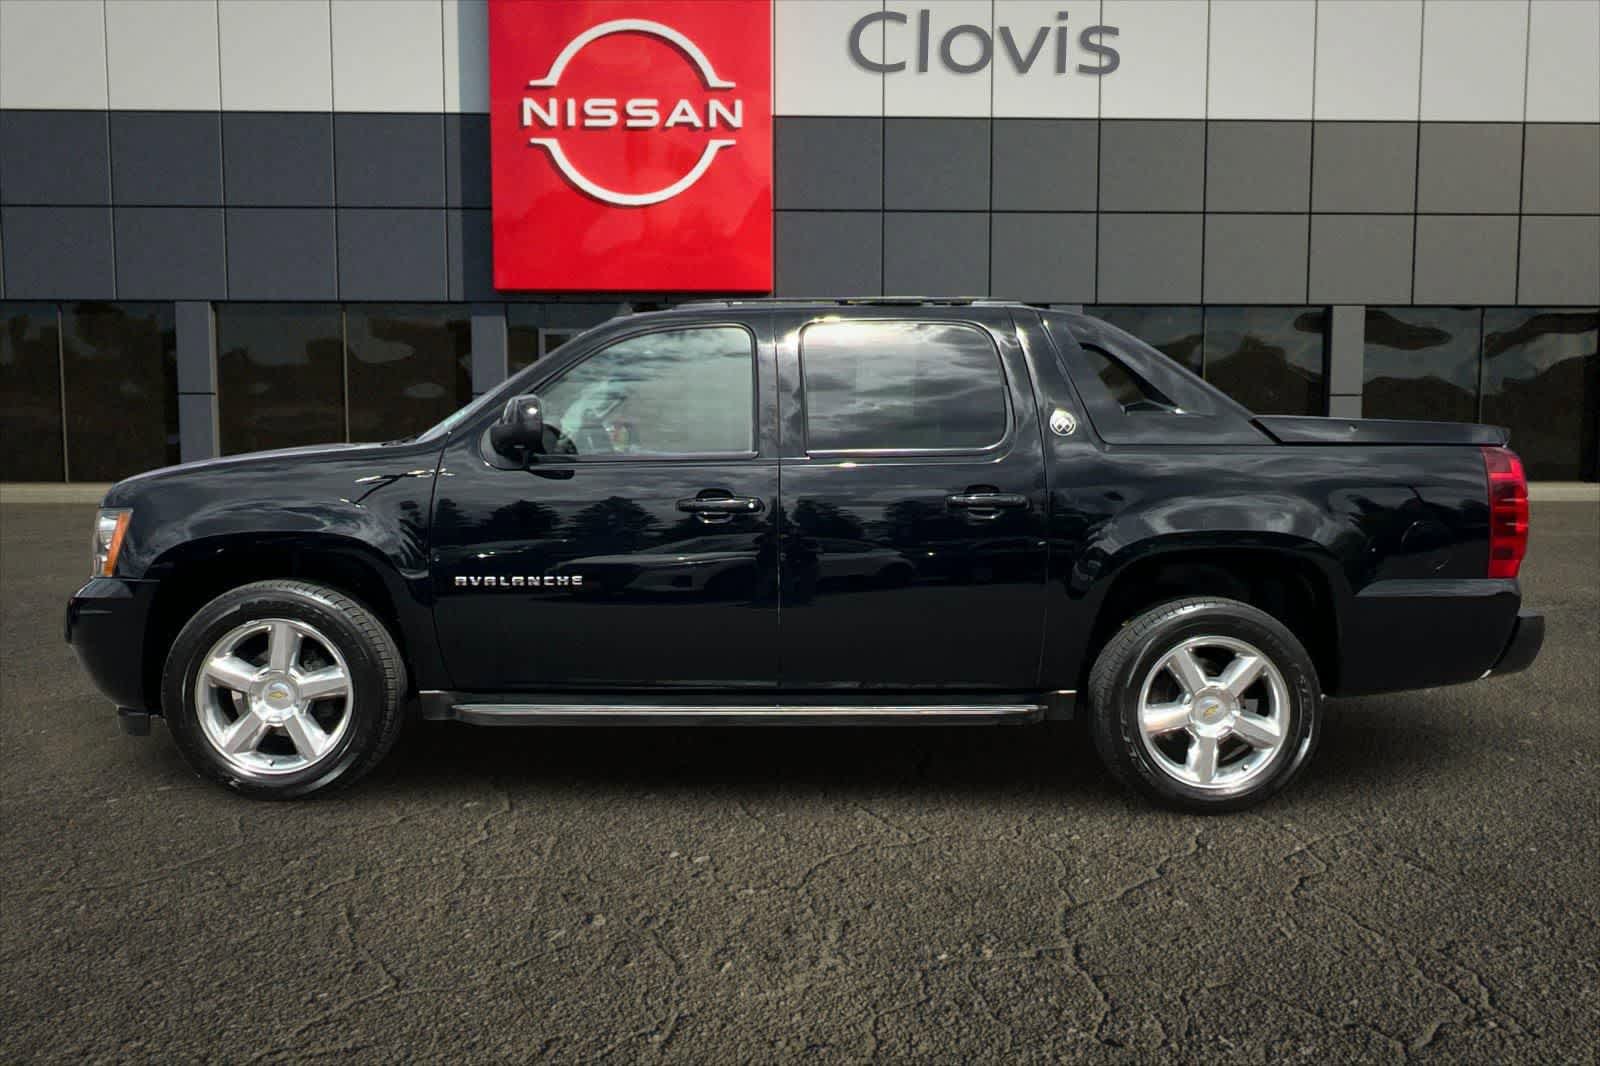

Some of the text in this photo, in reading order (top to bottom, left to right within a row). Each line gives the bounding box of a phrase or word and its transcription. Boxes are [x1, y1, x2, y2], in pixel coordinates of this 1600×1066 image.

[849, 9, 1121, 75] Clovis
[522, 97, 743, 129] NISSAN
[454, 576, 583, 586] AVALANCHE
